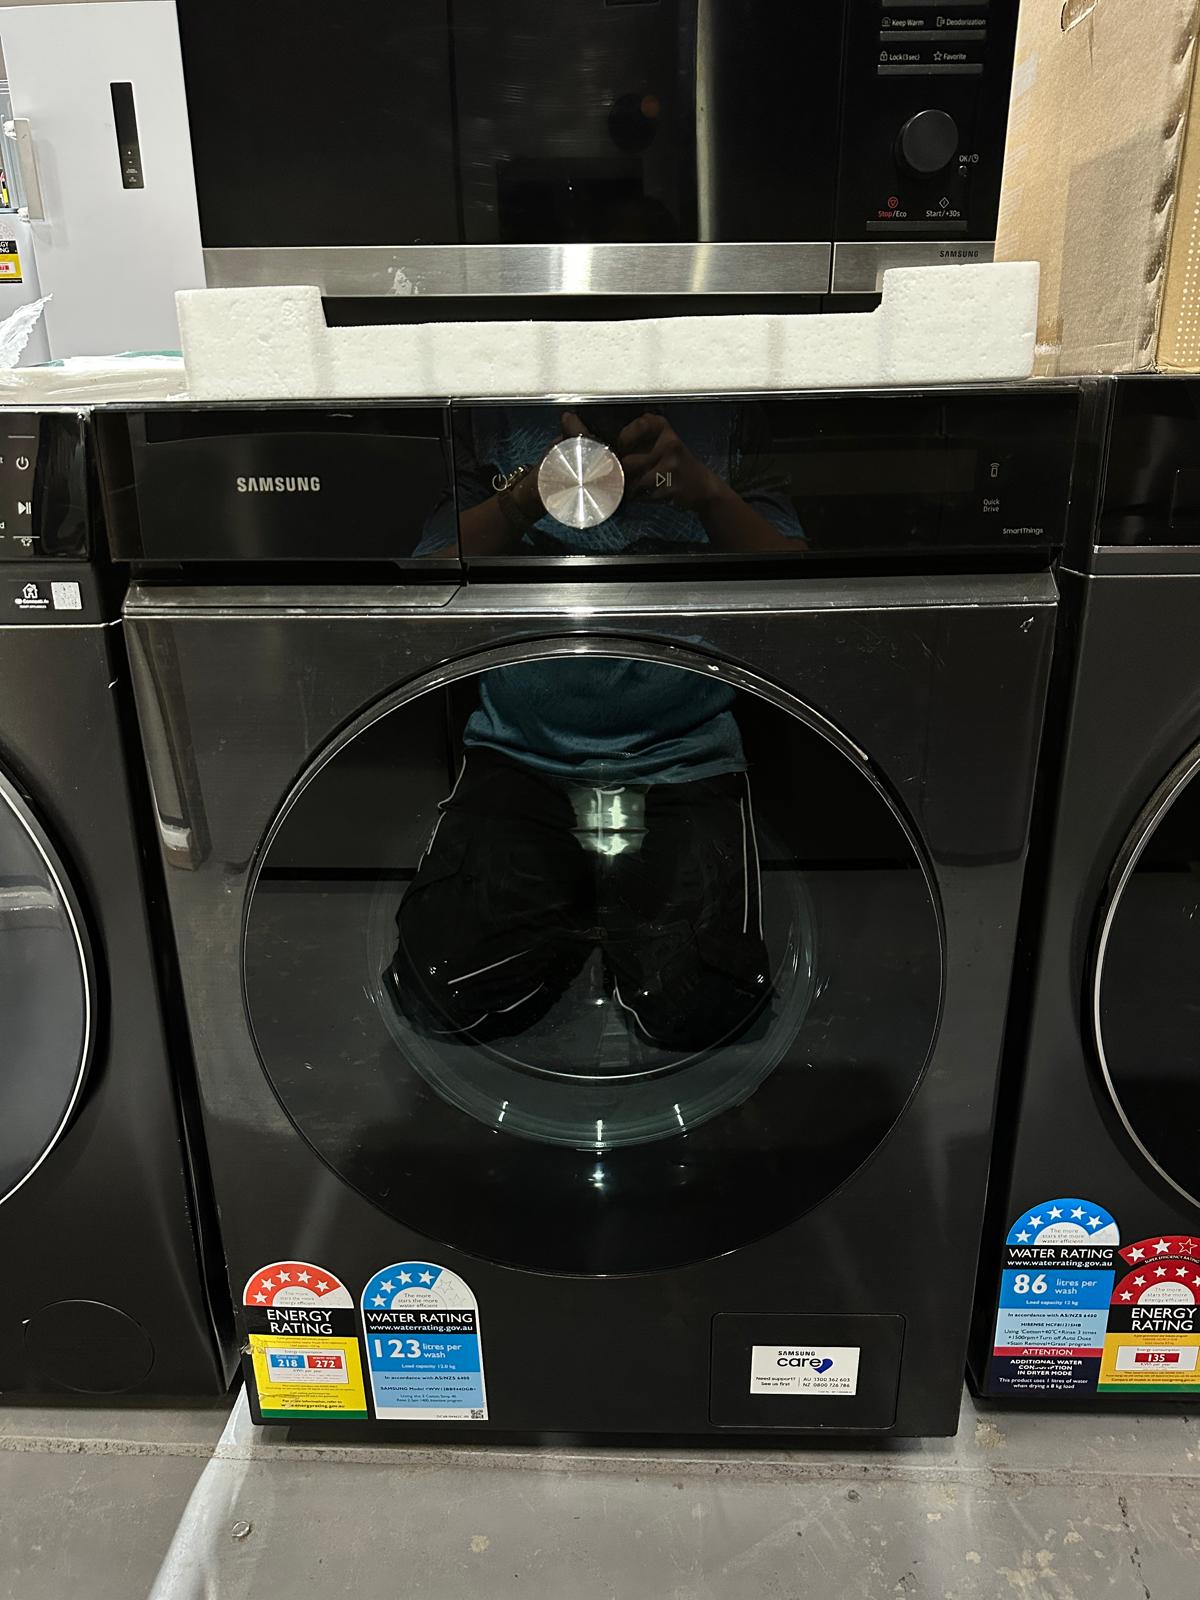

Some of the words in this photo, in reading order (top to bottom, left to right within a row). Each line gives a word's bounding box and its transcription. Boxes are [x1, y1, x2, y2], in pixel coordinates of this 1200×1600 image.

[892, 19, 907, 27] Keep
[943, 52, 966, 60] Favorite
[939, 250, 979, 258] SAMSUNG
[236, 476, 321, 492] SAMSUNG
[983, 498, 1000, 506] Quick
[1002, 527, 1044, 535] SmartThings
[1009, 1248, 1056, 1259] WATER
[1060, 1248, 1114, 1259] RATING
[1007, 1259, 1113, 1268] www.waterrating.gov.au
[1013, 1273, 1048, 1294] 86
[1056, 1278, 1079, 1287] litres
[1081, 1280, 1098, 1288] per
[1054, 1287, 1078, 1295] wash
[266, 1309, 333, 1322] ENERGY
[367, 1312, 416, 1323] WATER
[420, 1312, 473, 1323] RATING
[1131, 1307, 1198, 1319] ENERGY
[270, 1322, 333, 1335] RATING
[369, 1324, 473, 1332] www.waterrating.gov.au
[1131, 1319, 1194, 1331] RATING
[374, 1339, 421, 1358] 123
[422, 1343, 445, 1351] litres
[447, 1344, 462, 1352] per
[1022, 1348, 1073, 1356] ATTENTION
[423, 1351, 446, 1359] wash
[1147, 1353, 1166, 1362] 135
[277, 1359, 298, 1367] 218
[315, 1360, 336, 1368] 272
[776, 1357, 822, 1368] care
